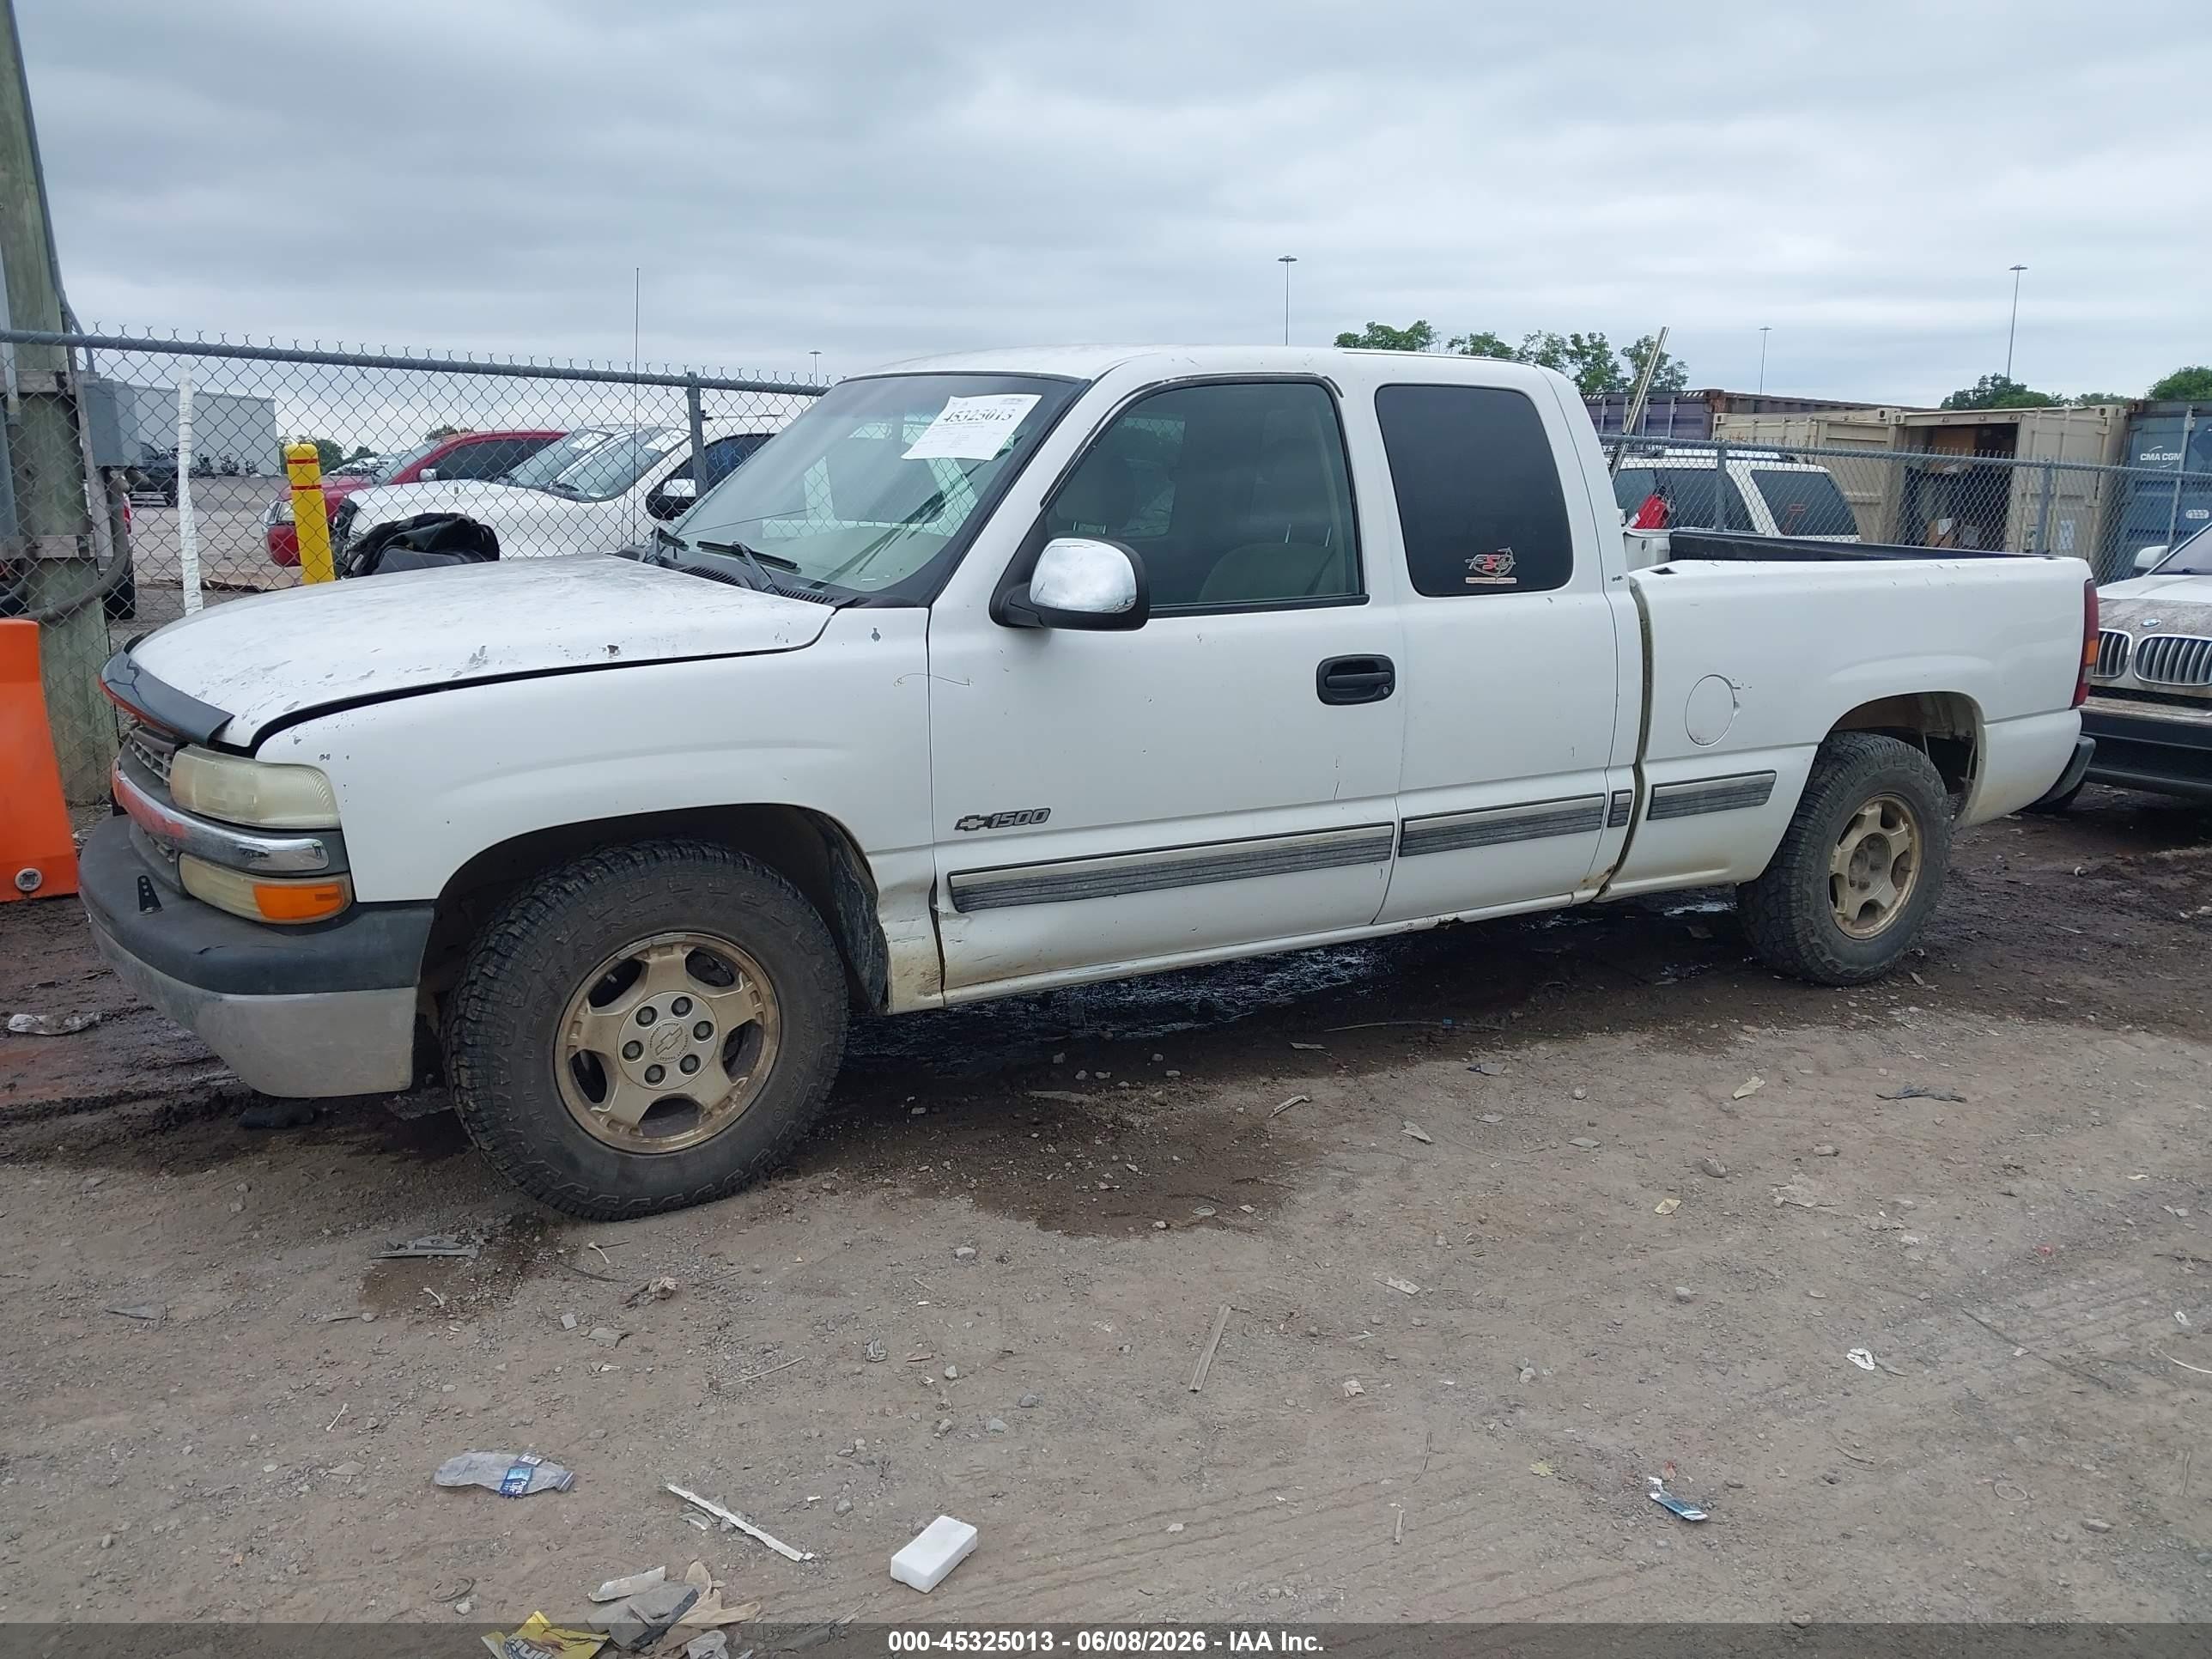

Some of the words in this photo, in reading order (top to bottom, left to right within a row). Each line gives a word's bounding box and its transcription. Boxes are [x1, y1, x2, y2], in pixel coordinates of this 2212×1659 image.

[943, 409, 1016, 422] 45325013
[2140, 453, 2160, 461] CMA
[989, 809, 1050, 829] 1500
